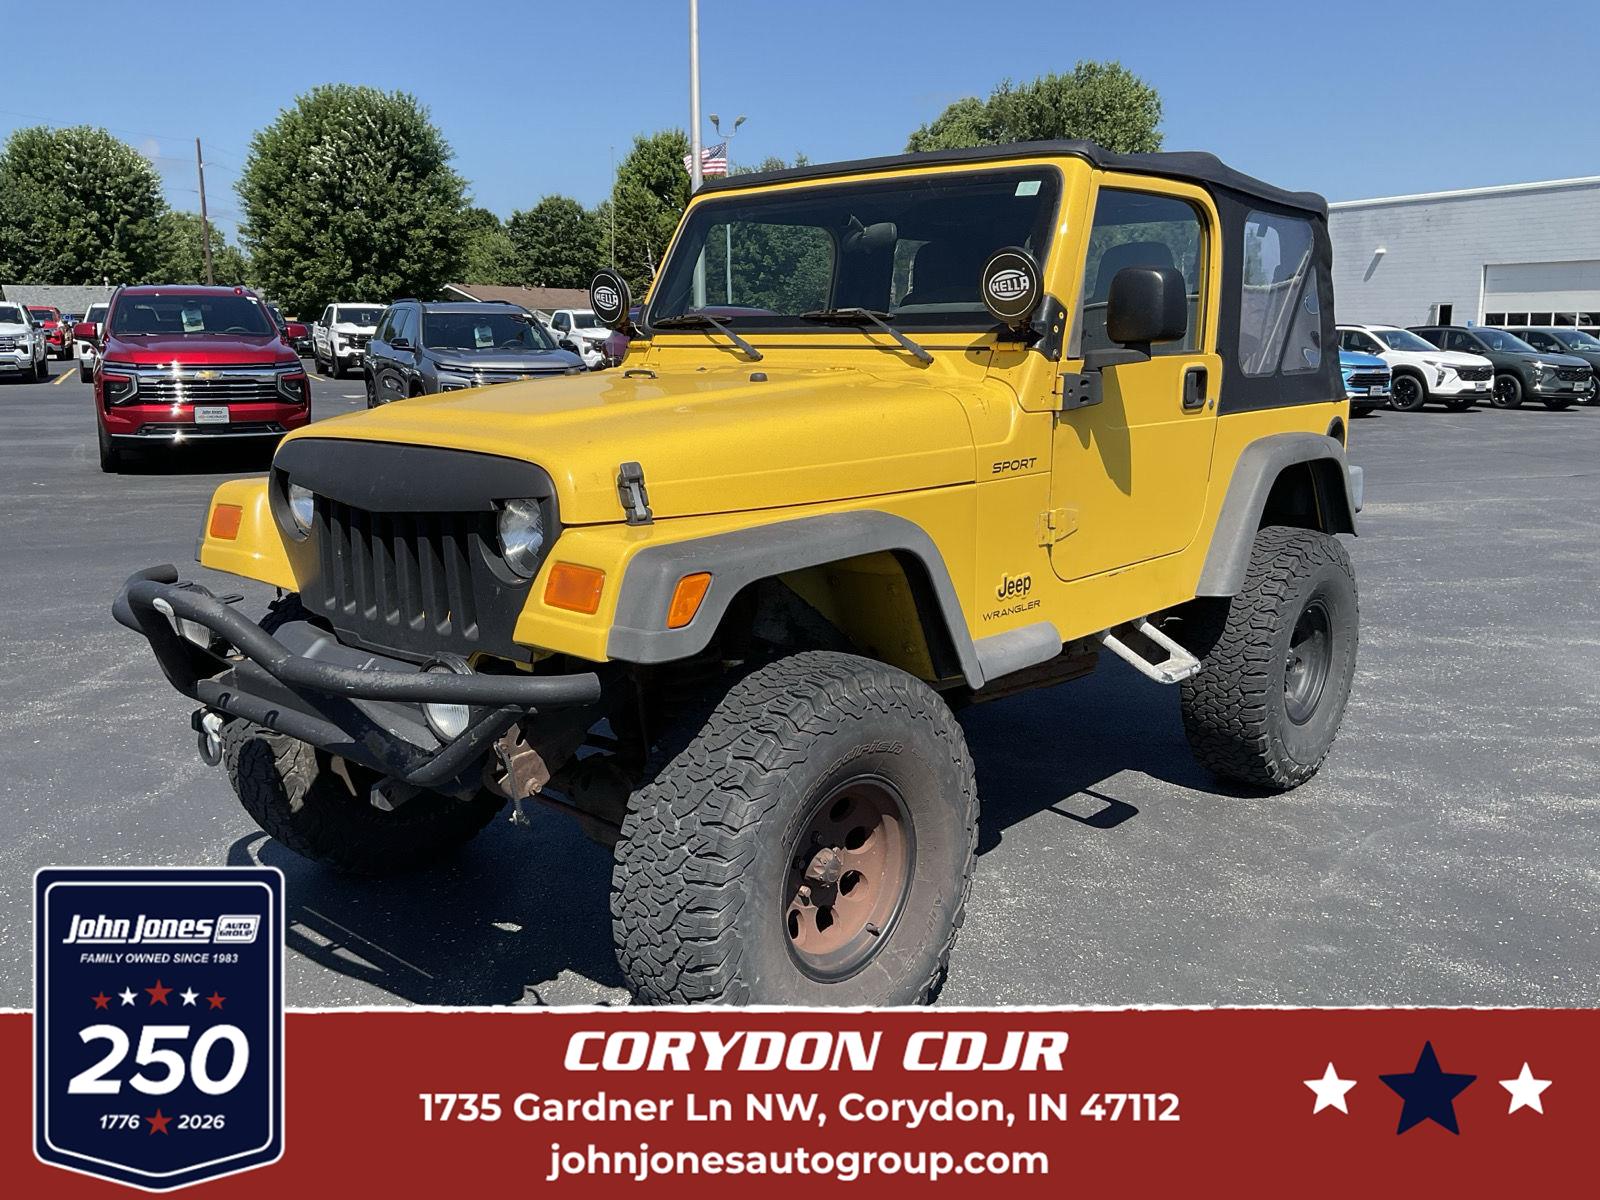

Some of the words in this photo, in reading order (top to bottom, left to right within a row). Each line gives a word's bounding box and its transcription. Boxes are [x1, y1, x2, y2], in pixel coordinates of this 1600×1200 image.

[992, 275, 1030, 292] HELLA
[596, 293, 619, 306] HELLA
[992, 457, 1037, 474] SPORT
[997, 574, 1032, 599] Jeep
[982, 599, 1041, 621] WRANGLER
